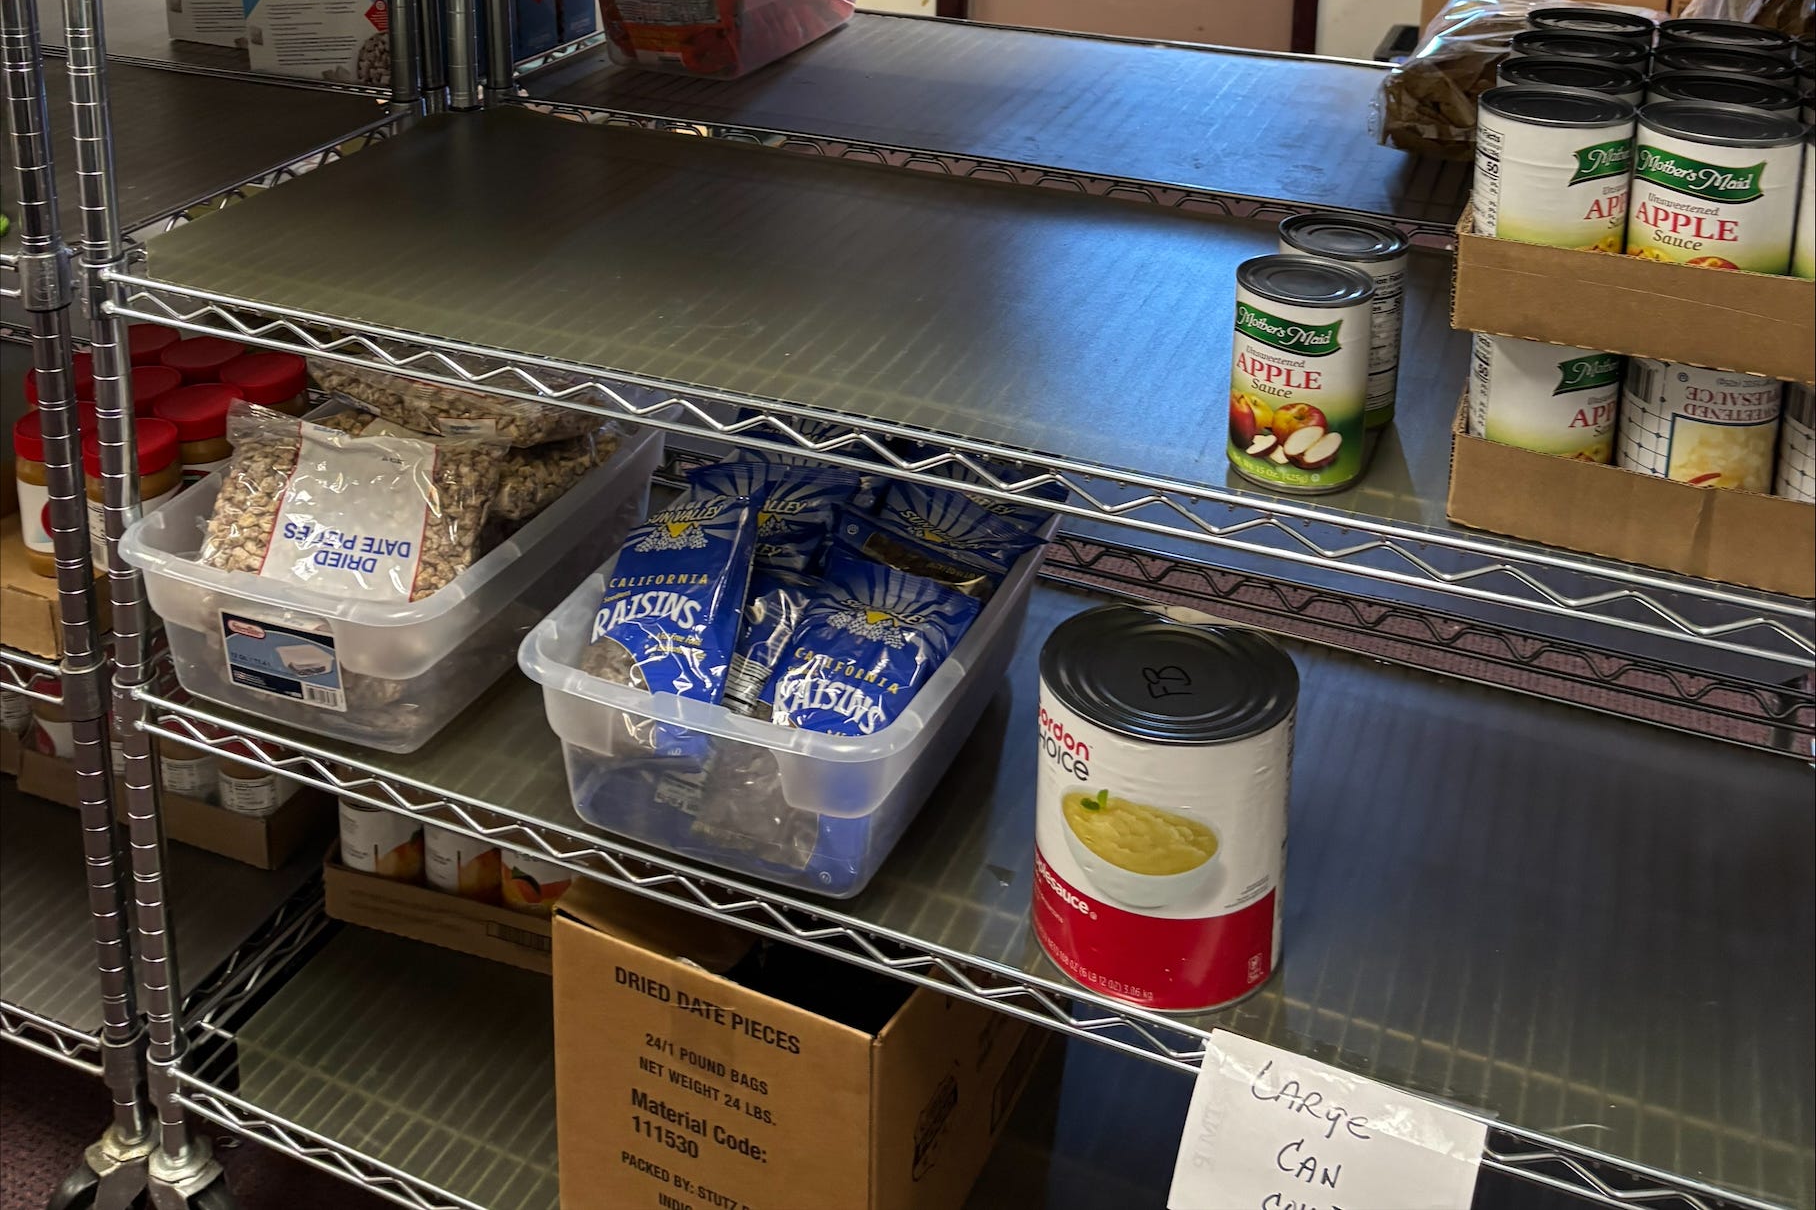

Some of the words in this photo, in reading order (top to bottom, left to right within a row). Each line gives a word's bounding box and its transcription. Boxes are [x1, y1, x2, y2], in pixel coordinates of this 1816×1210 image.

[1638, 149, 1698, 182] Mother's
[1688, 168, 1754, 191] Maid
[1634, 201, 1740, 242] APPLE
[1648, 192, 1720, 217] Unsweetened
[1653, 229, 1704, 251] Sauce
[1236, 306, 1287, 338] Mother's
[1279, 325, 1334, 347] Maid
[1236, 351, 1323, 391] APPLE
[1245, 343, 1305, 370] Unsweetened
[1250, 378, 1294, 399] Sauce
[673, 503, 725, 523] VALLEY
[763, 499, 808, 514] LLEY
[283, 521, 360, 550] PIEES
[361, 535, 412, 560] DATE
[313, 548, 378, 574] DRIED
[608, 573, 710, 589] CALIFORNIA
[590, 590, 702, 644] RAISINS
[793, 646, 900, 696] CALIFORNIA
[1038, 707, 1090, 762] ordon
[614, 965, 671, 1004] DRIED
[676, 990, 726, 1027] DATE
[730, 1009, 801, 1055] PIECES
[645, 1032, 676, 1057] 24/1
[679, 1042, 726, 1078] POUND
[730, 1067, 769, 1096] BAGS
[639, 1055, 665, 1077] NET
[668, 1064, 721, 1102] WEIGHT
[723, 1092, 742, 1110] 24
[745, 1101, 778, 1126] LBS.
[630, 1087, 708, 1138] Material
[712, 1123, 768, 1164] Code:
[631, 1114, 700, 1160] 111530
[621, 1150, 671, 1183] PACKED
[673, 1174, 695, 1195] BY:
[697, 1185, 739, 1210] STUTZ
[1277, 1138, 1342, 1189] CAN
